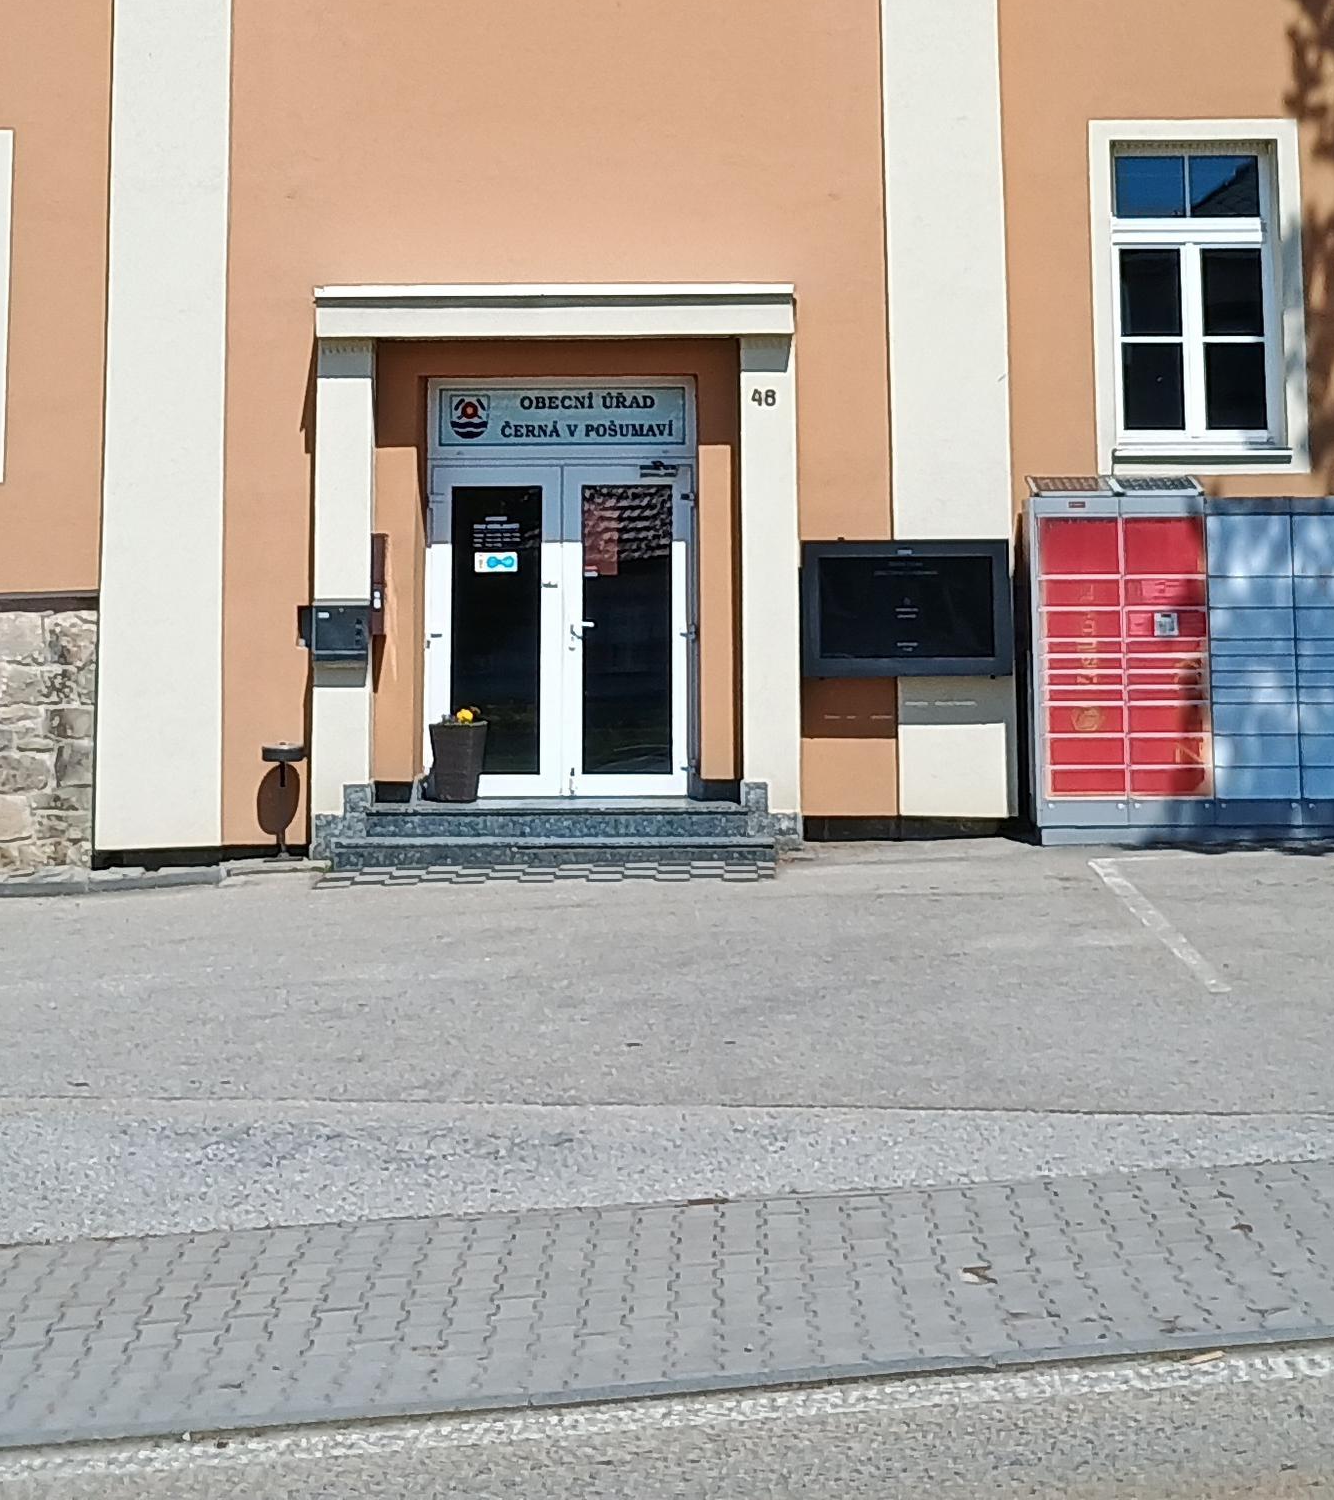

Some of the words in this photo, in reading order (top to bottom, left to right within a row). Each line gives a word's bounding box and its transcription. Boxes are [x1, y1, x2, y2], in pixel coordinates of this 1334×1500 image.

[520, 391, 594, 411] OBECNÍ
[602, 391, 655, 410] ÚŘAD
[751, 388, 776, 407] 48
[500, 420, 560, 438] ČERNÁ
[566, 423, 579, 437] V
[584, 419, 674, 438] POŠUMAVÍ
